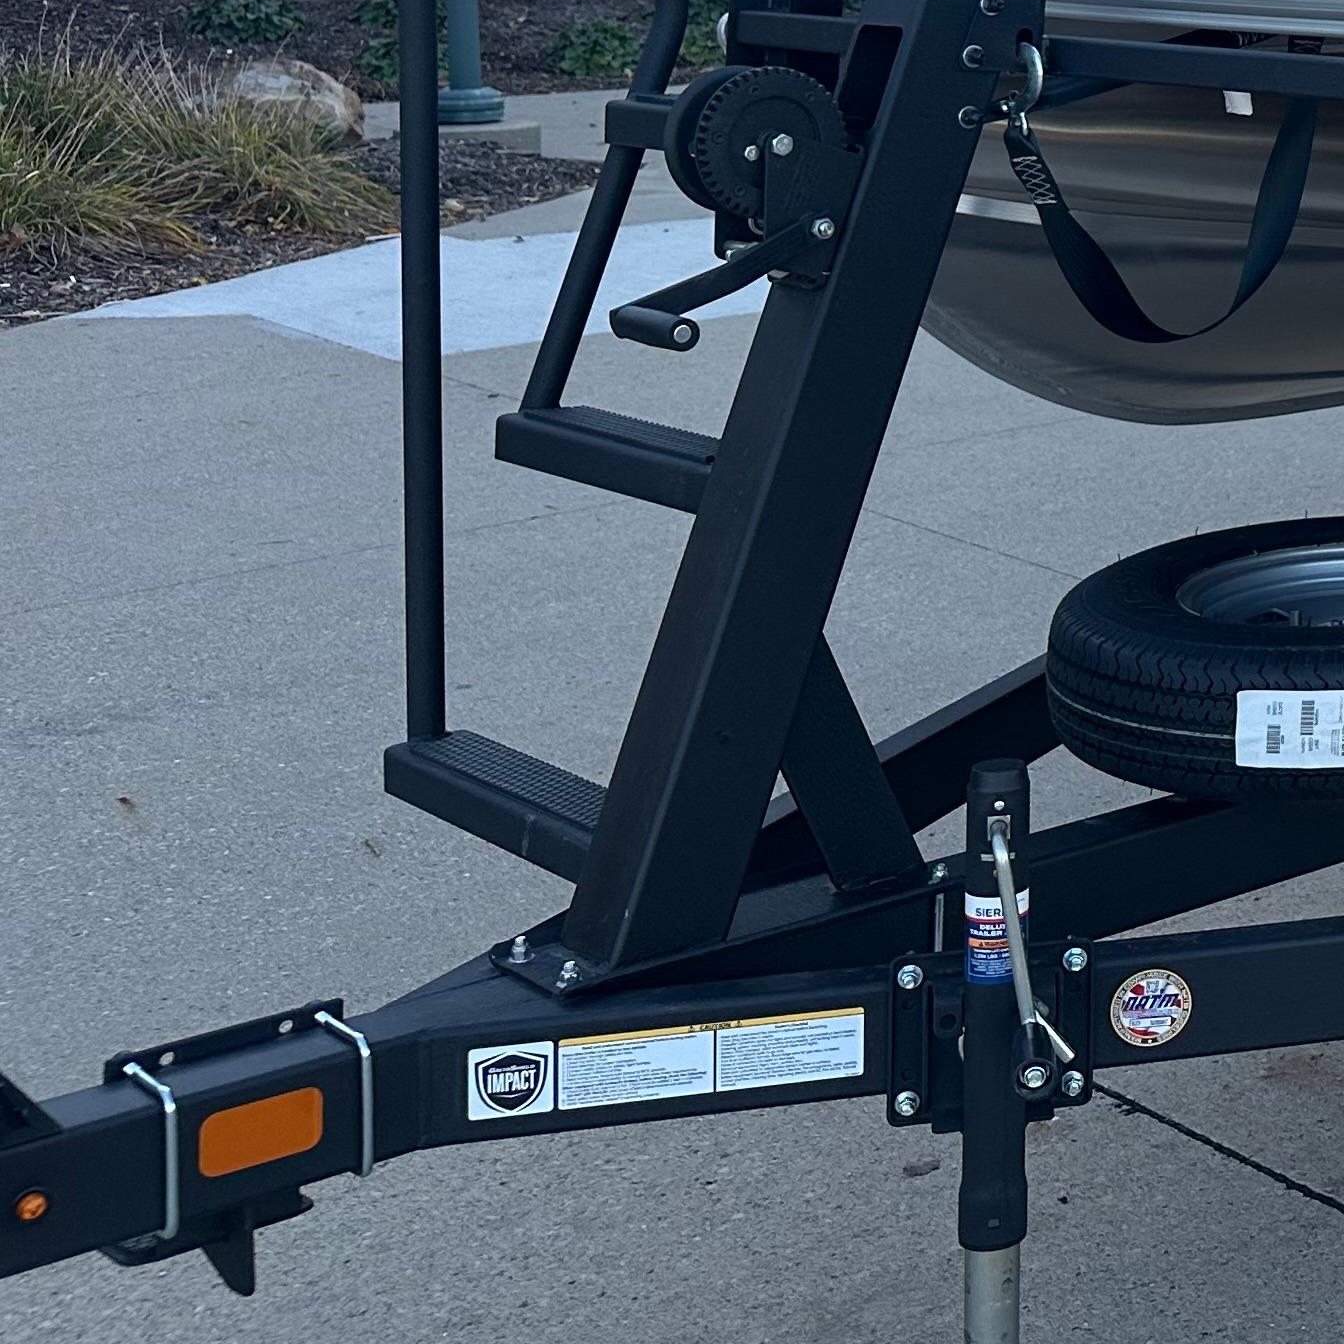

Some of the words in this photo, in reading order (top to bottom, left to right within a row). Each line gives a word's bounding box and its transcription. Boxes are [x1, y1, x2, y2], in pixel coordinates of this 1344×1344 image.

[975, 907, 1004, 918] SIER
[969, 928, 1003, 937] TRAILER
[487, 1069, 537, 1094] IMPACT
